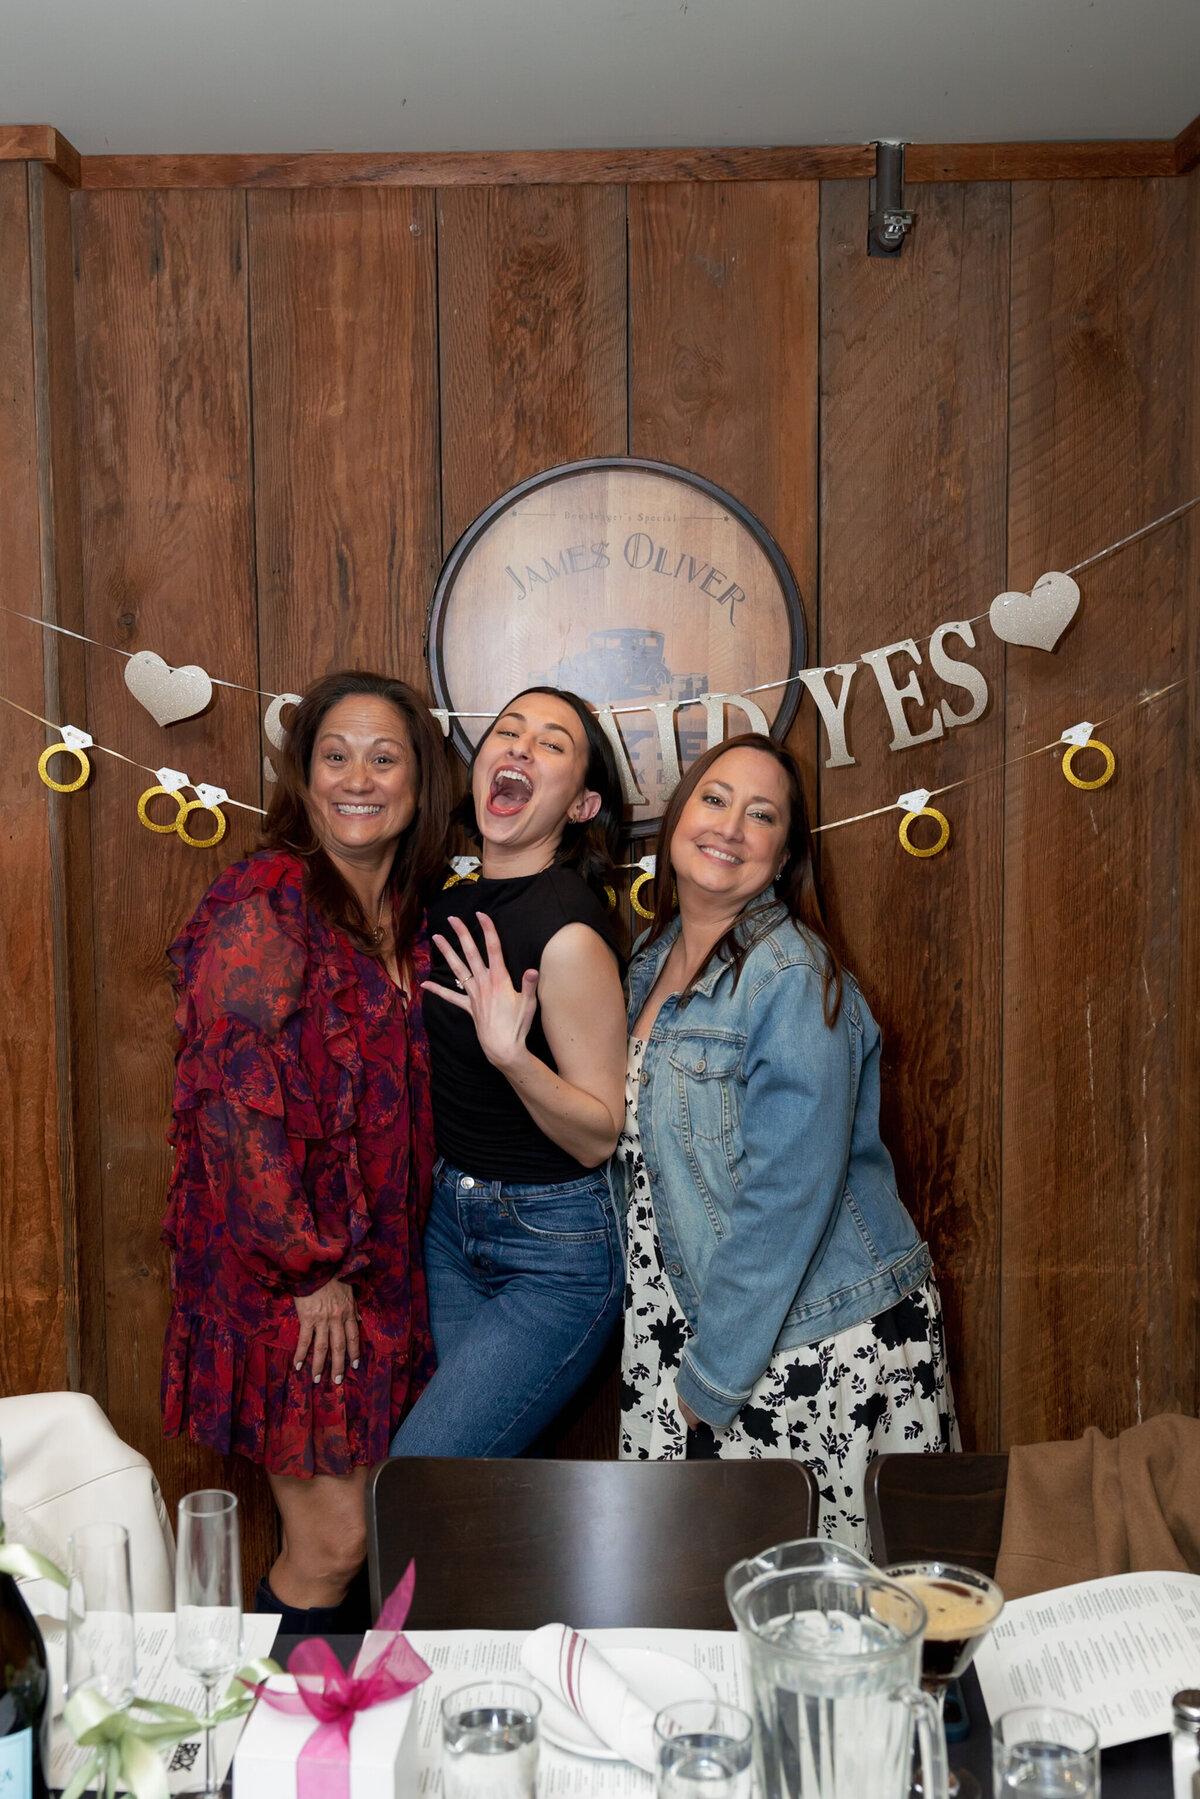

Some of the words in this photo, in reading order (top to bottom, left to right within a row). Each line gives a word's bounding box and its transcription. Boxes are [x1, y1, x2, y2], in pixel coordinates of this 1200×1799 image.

[637, 512, 677, 525] Special
[505, 541, 611, 601] JAMES
[623, 532, 747, 627] OLIVER
[798, 620, 989, 769] YES
